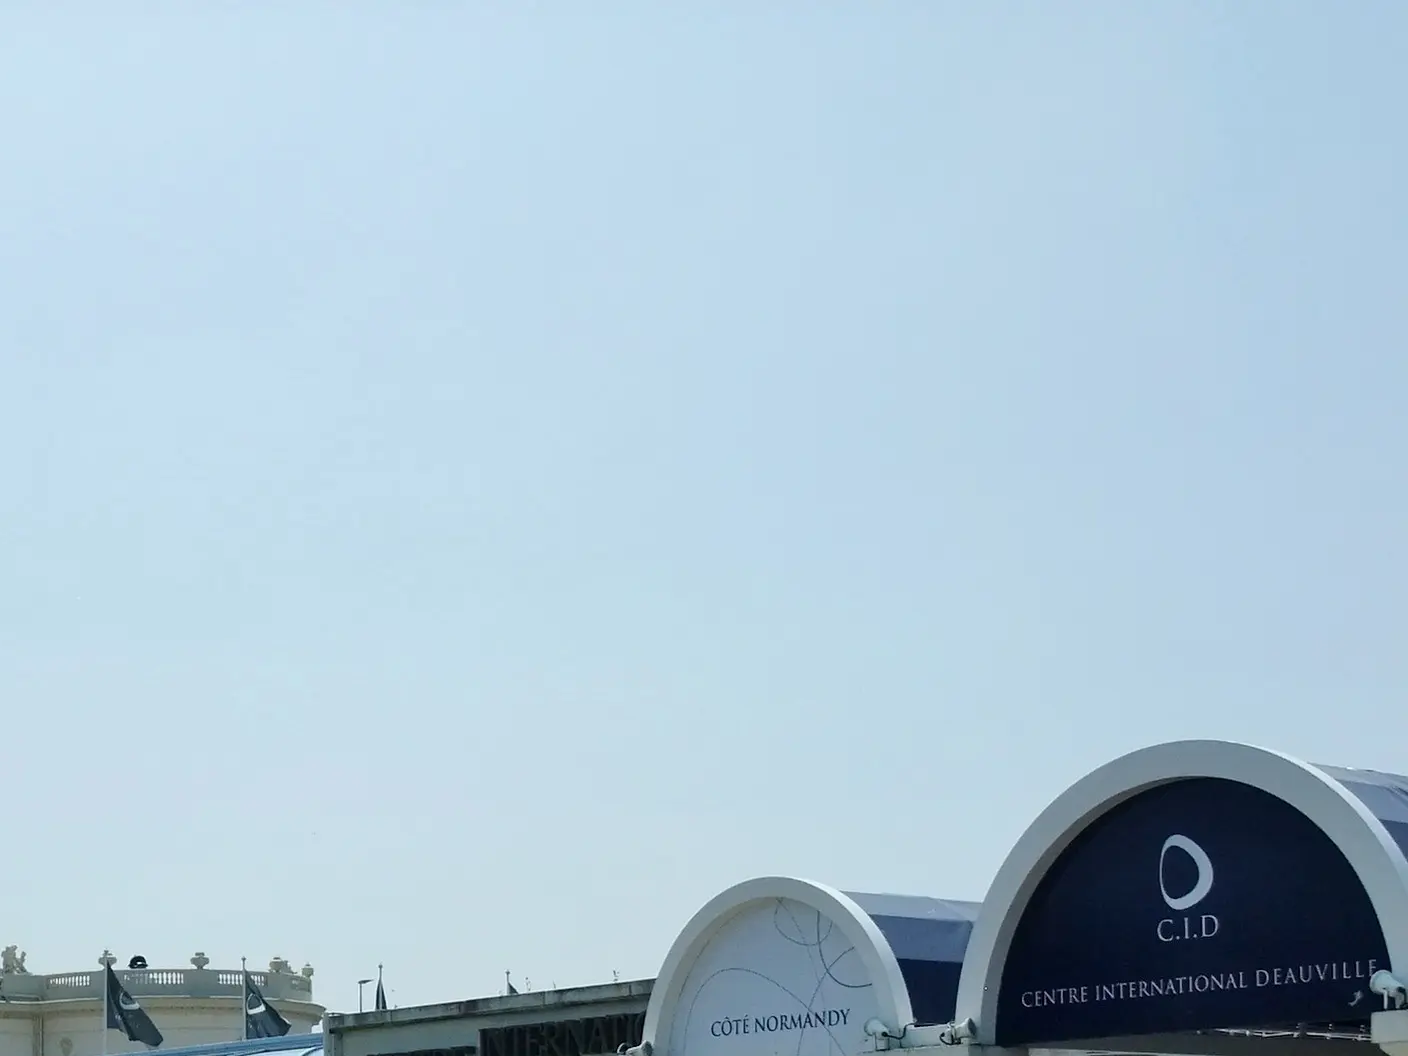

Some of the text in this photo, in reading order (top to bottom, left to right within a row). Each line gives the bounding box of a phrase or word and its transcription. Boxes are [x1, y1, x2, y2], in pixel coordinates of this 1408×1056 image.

[1156, 914, 1220, 942] C.I.D
[1021, 958, 1378, 1009] CENTRE INTERNATIONAL DEAUVILLE
[710, 1008, 851, 1037] CÔTÉ NORMANDY
